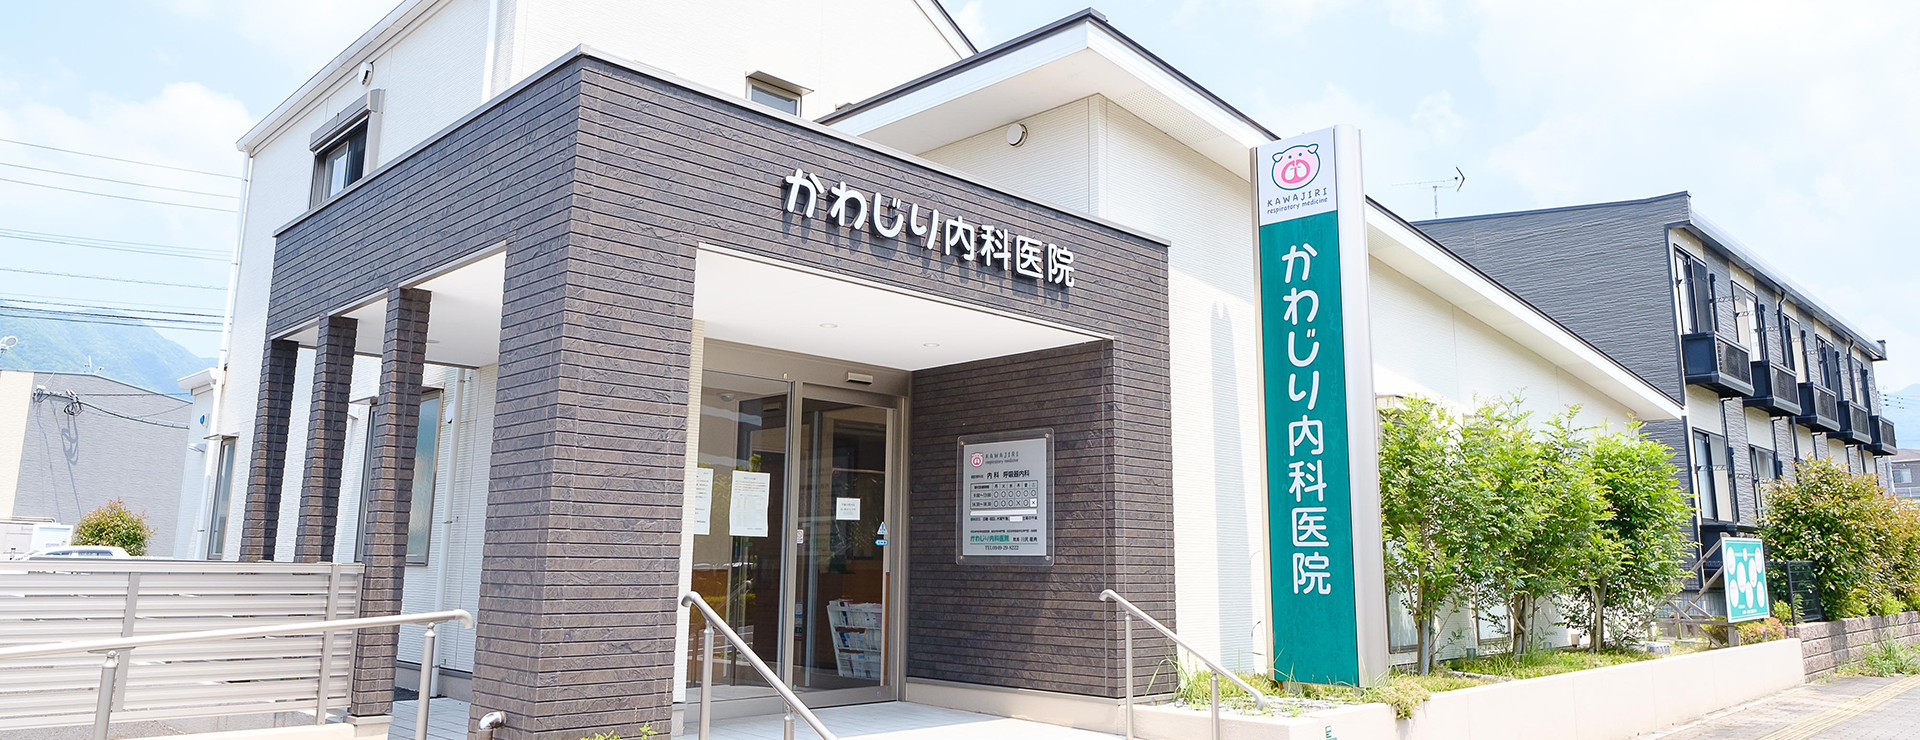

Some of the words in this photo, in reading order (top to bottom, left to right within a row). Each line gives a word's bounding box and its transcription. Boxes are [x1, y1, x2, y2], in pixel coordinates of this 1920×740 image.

[1267, 187, 1327, 207] KAWAJIRI
[1267, 203, 1300, 214] respiratory
[1302, 197, 1328, 207] medicine
[785, 168, 1075, 288] かわじり内科医院
[1282, 242, 1332, 595] かわじり内科医院
[985, 451, 1019, 459] KAWAJIRI
[970, 534, 1010, 542] かわじり内科医院
